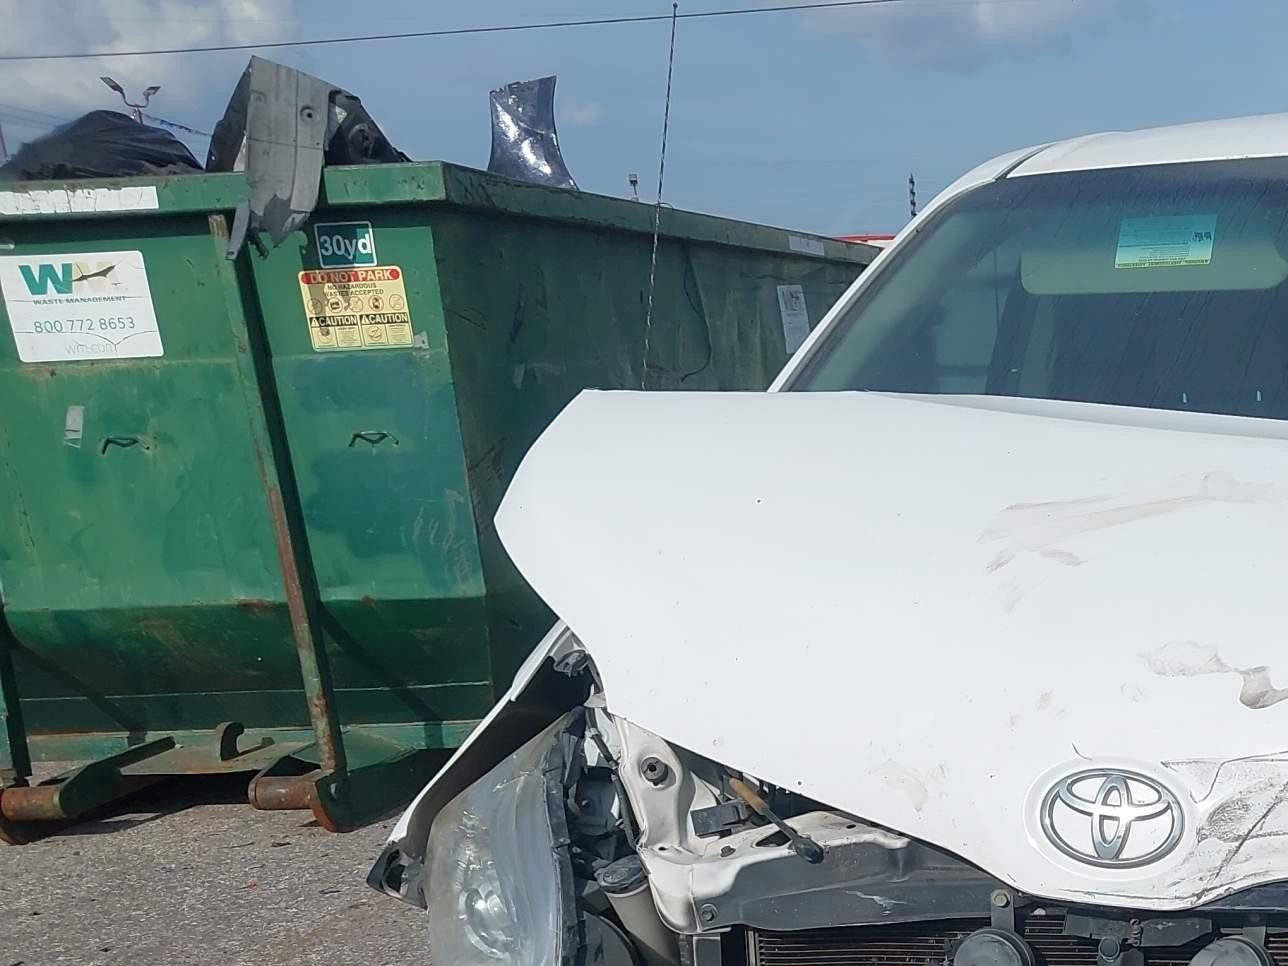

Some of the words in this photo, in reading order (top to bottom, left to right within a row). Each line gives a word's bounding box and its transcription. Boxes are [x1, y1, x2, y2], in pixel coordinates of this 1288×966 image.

[320, 233, 373, 260] 30yd
[310, 272, 328, 284] DO
[330, 271, 357, 283] NOT
[358, 269, 393, 281] PARK
[350, 288, 384, 296] ACCEPTED
[33, 298, 63, 306] WASTE
[65, 295, 127, 304] MANAGEMENT
[319, 315, 358, 327] CAUTION
[368, 312, 408, 324] CAUTION
[34, 319, 63, 334] 800
[66, 318, 95, 332] 772
[99, 316, 136, 331] 8653
